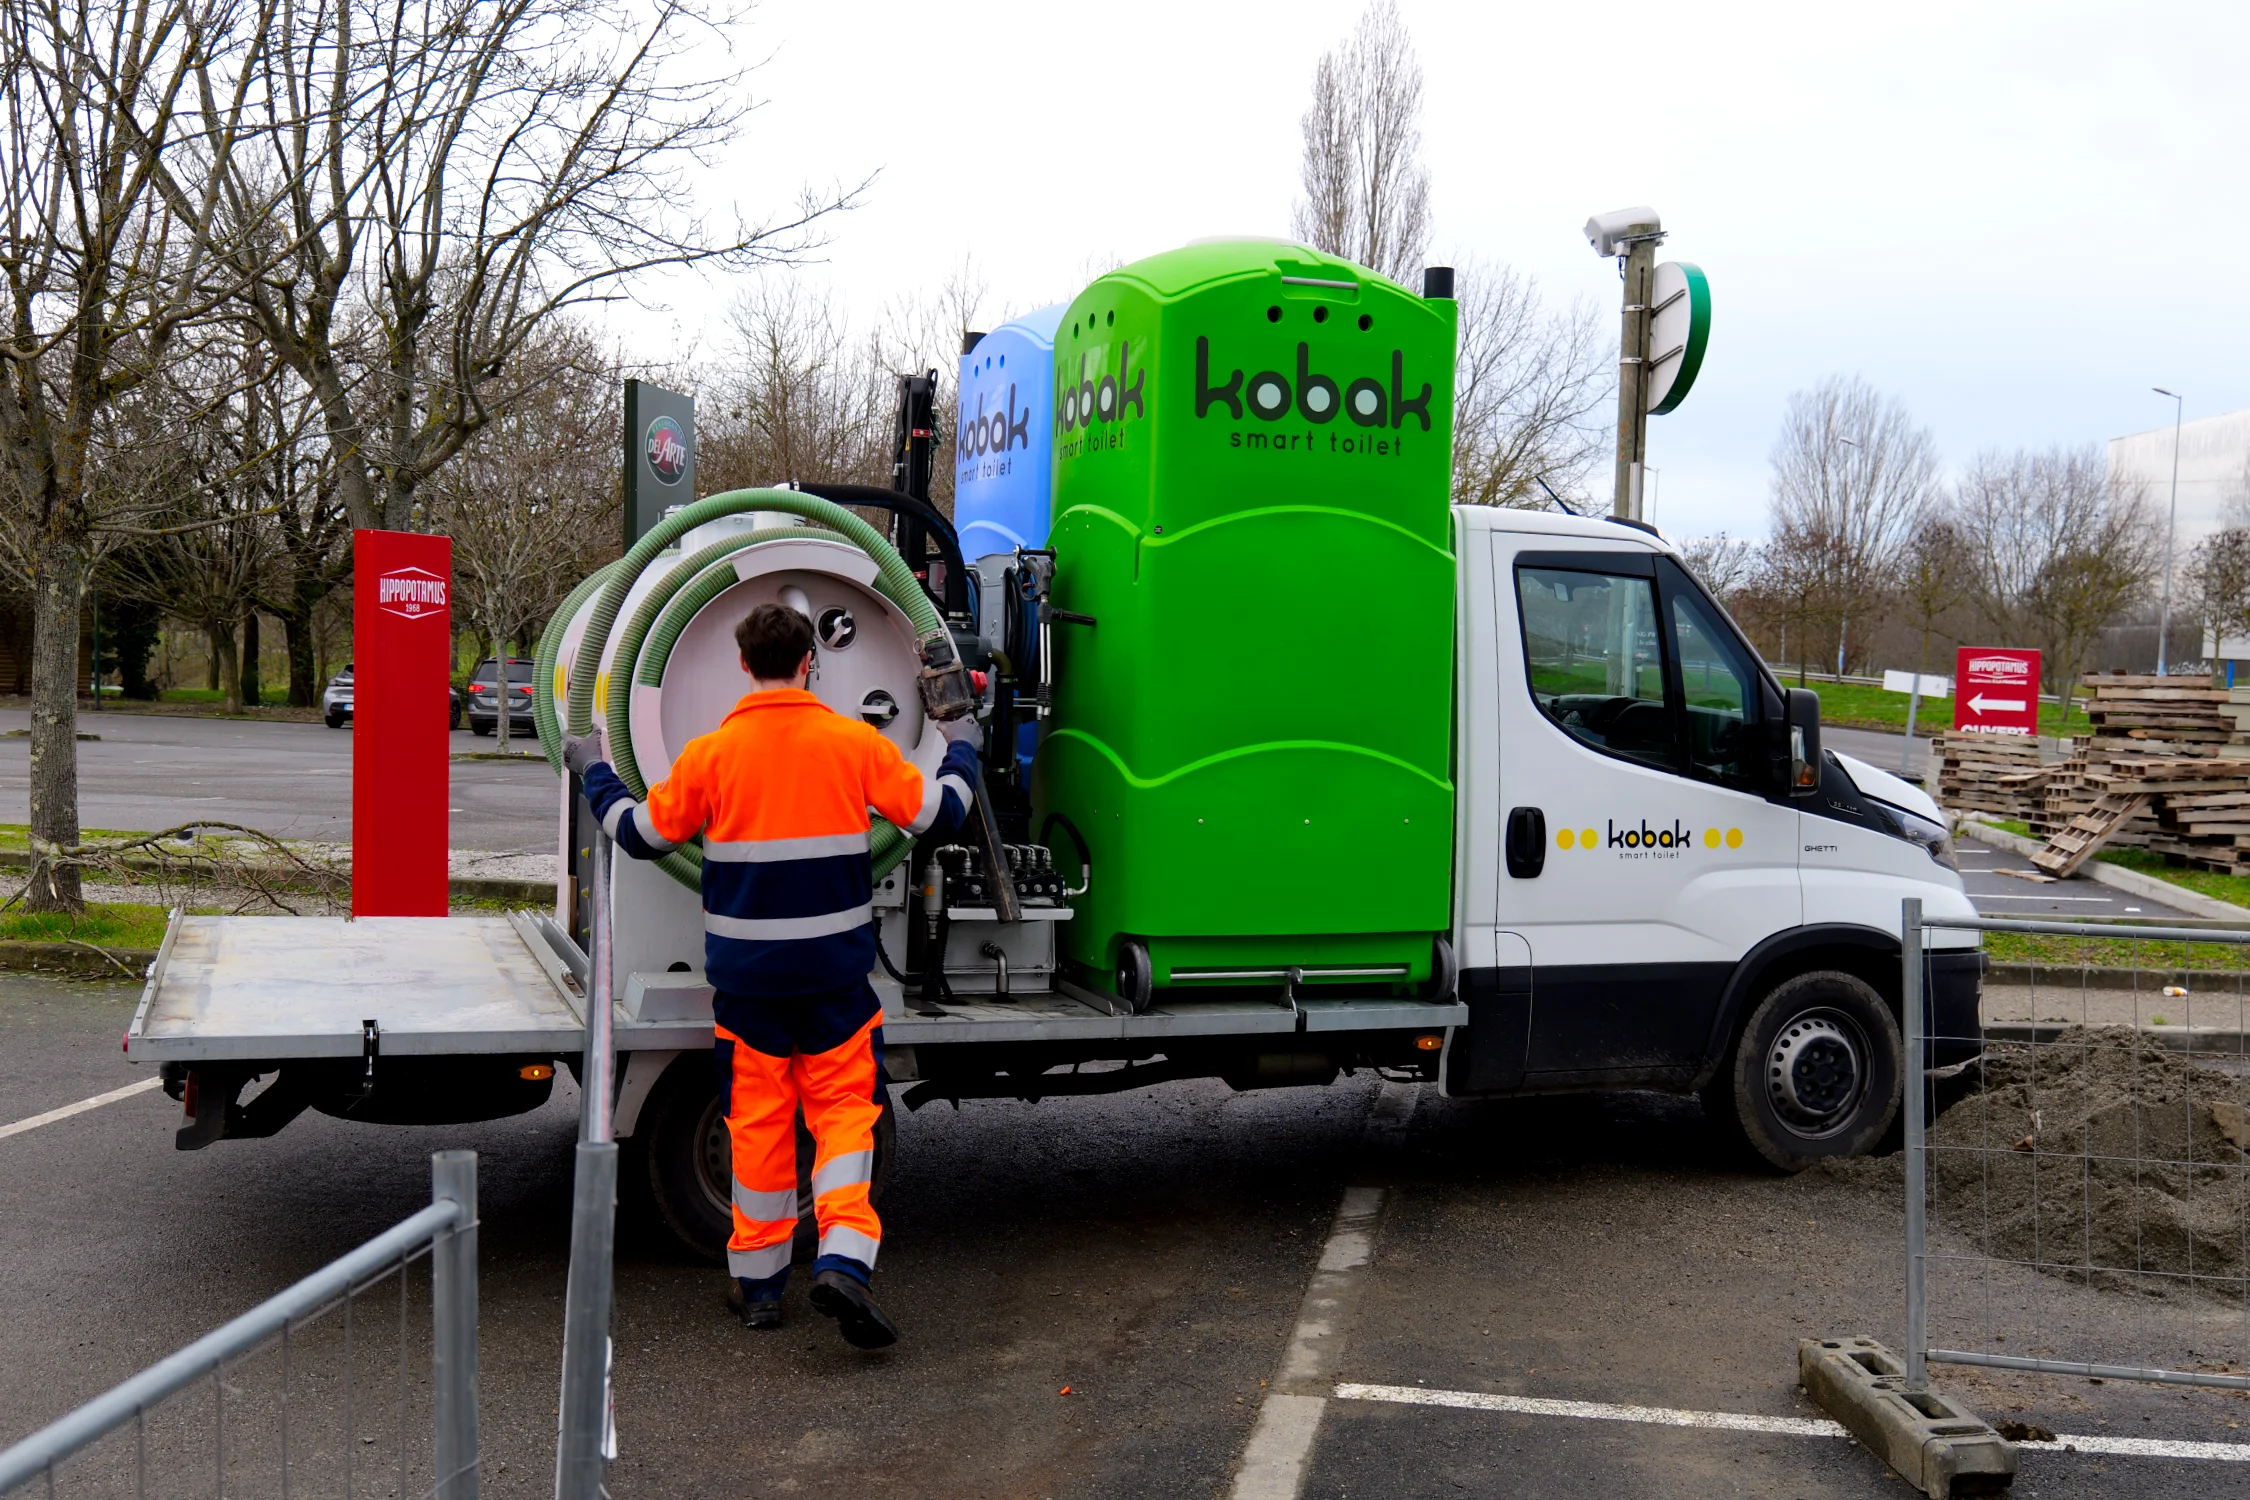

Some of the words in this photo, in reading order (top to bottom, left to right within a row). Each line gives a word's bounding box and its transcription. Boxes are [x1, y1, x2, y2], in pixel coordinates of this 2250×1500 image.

[1055, 340, 1145, 438] kobak
[1195, 335, 1432, 432] kobak
[958, 382, 1029, 465] kobak
[1059, 439, 1084, 460] smart
[1087, 428, 1125, 452] toilet
[1230, 430, 1313, 451] smart
[1330, 431, 1401, 456] toilet
[960, 462, 979, 485] smart
[982, 457, 1012, 478] toilet
[380, 578, 445, 604] HIPPOPOTAMUS
[405, 603, 420, 612] 1968
[1969, 661, 2028, 674] HIPPOPOTAMUS
[1608, 818, 1690, 849] kobak
[1619, 851, 1648, 860] smart
[1652, 850, 1680, 860] toilet
